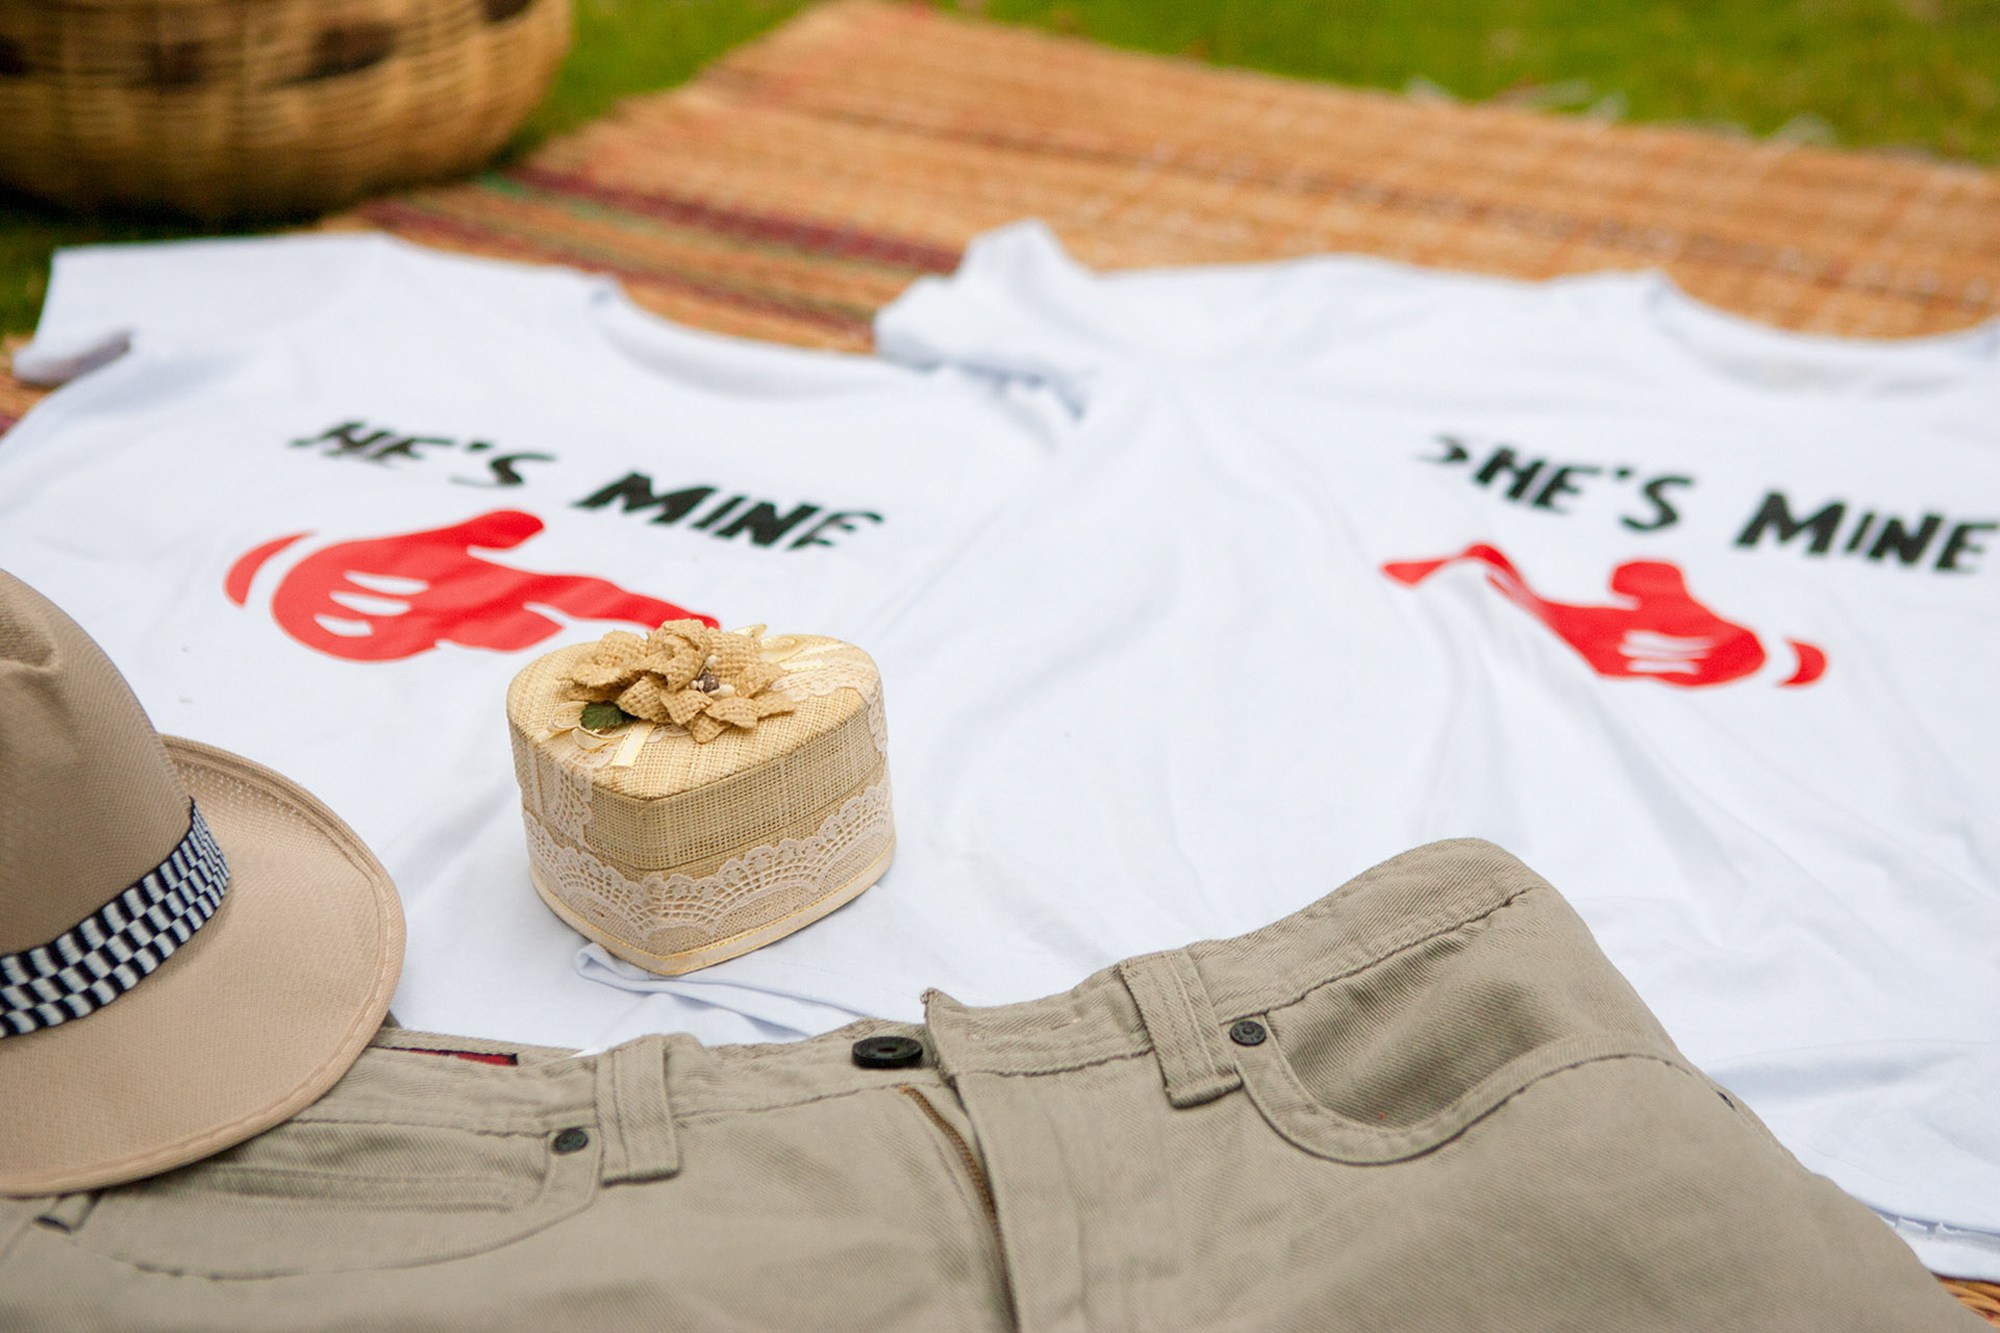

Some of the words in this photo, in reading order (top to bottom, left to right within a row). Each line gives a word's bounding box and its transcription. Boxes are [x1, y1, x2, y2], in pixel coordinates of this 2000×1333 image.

[289, 419, 557, 488] HE'S
[572, 470, 884, 550] MINE
[1733, 491, 2000, 572] MINE
